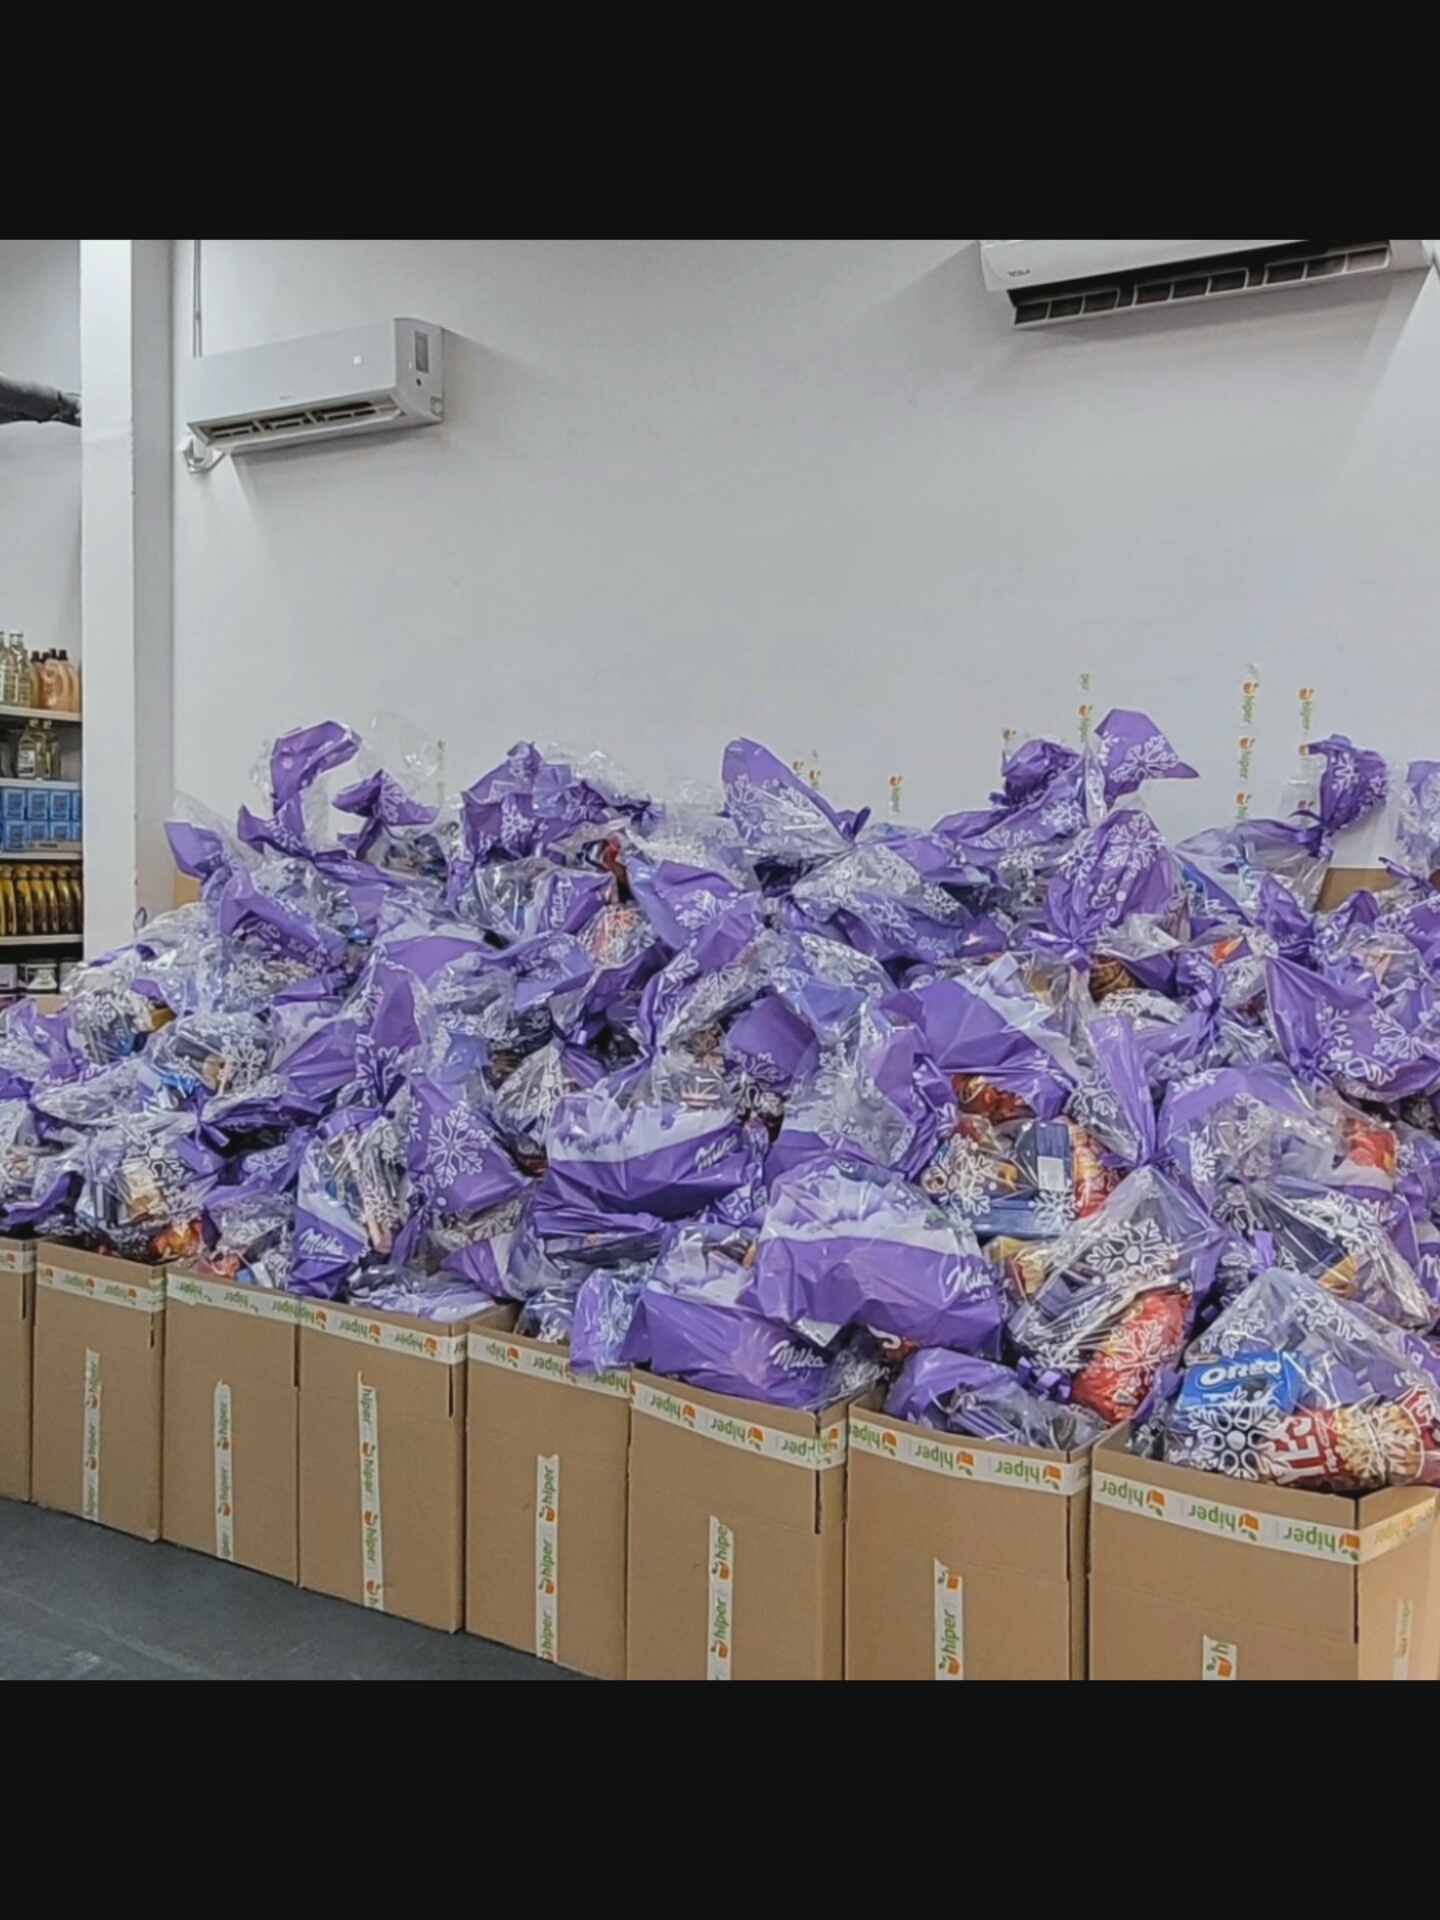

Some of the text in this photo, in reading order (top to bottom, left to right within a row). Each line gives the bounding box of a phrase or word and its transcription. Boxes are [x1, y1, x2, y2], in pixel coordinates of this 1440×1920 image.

[339, 1319, 368, 1338] hiper
[394, 1333, 424, 1351] hiper
[532, 1356, 564, 1378] hiper
[769, 1340, 828, 1372] Milka
[219, 1401, 229, 1436] hiper
[361, 1387, 373, 1425] hiper
[650, 1393, 681, 1418] hiper
[710, 1416, 746, 1443] hiper
[914, 1444, 954, 1469] hiper
[994, 1460, 1041, 1484] hiper
[219, 1466, 230, 1501] hiper
[362, 1458, 375, 1496] hiper
[541, 1465, 556, 1505] hiper
[1098, 1480, 1144, 1500] hiper
[1187, 1504, 1236, 1532] hiper
[365, 1527, 378, 1563] hiper
[1283, 1526, 1337, 1553] hiper
[540, 1538, 555, 1577] hiper
[541, 1610, 555, 1650] hiper
[713, 1597, 732, 1640] hiper
[940, 1609, 961, 1656] hiper
